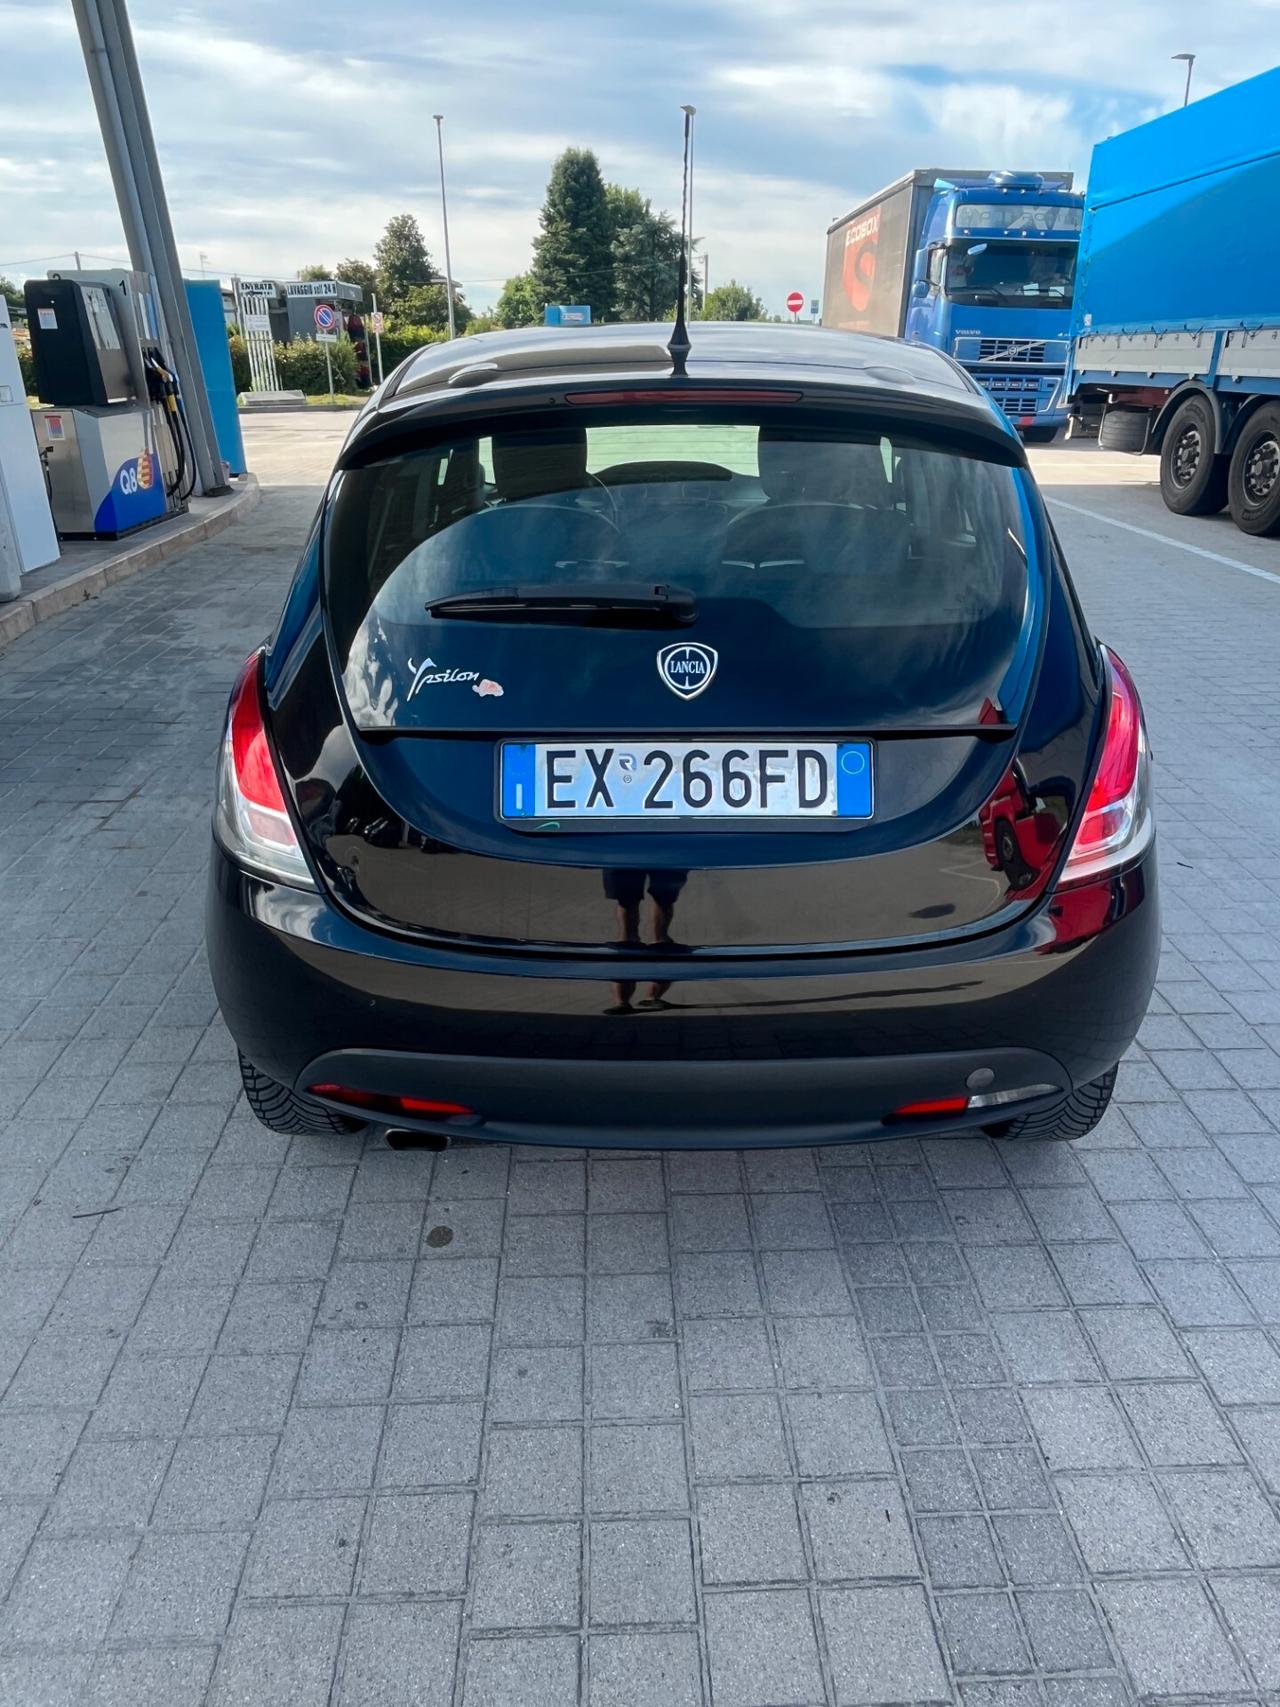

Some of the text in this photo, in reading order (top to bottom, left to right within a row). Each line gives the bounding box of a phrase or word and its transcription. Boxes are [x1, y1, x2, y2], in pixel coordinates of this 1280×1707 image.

[119, 280, 127, 296] 1
[241, 283, 273, 291] ENTRATA
[287, 283, 313, 296] LAVAGGIO
[324, 283, 332, 294] 24
[120, 467, 137, 495] Q8
[670, 660, 706, 674] LANCIA
[406, 657, 480, 702] Ypsilon
[546, 748, 615, 809] EX
[643, 748, 828, 809] 266FD
